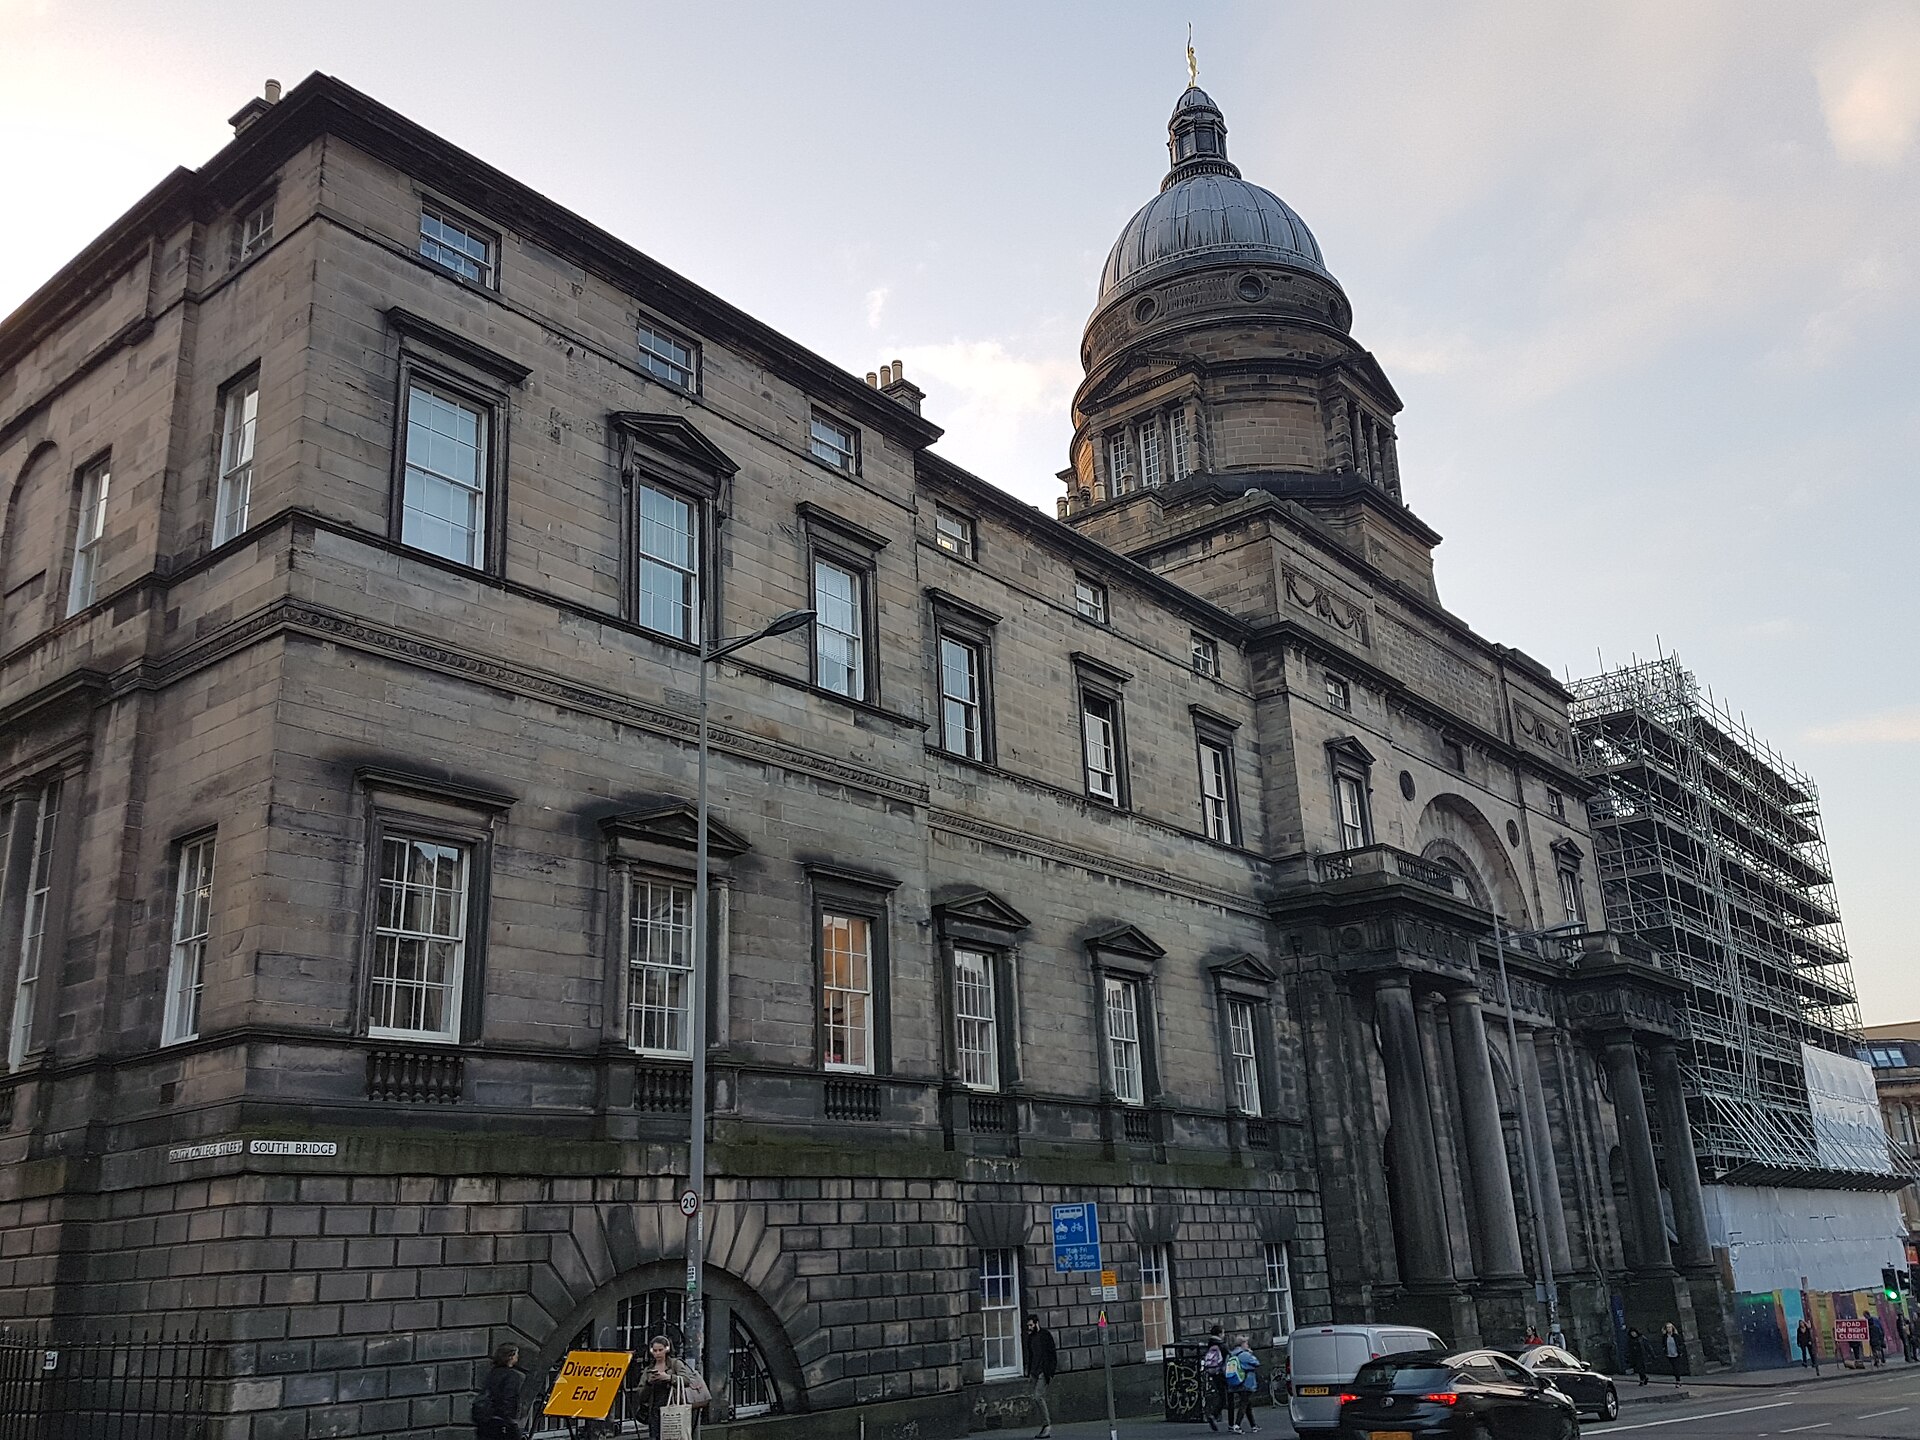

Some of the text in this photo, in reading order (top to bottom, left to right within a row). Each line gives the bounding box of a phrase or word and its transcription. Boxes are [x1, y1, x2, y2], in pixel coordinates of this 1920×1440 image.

[191, 1145, 217, 1158] COLLEGE
[219, 1141, 242, 1155] STREET
[253, 1142, 334, 1155] SOUTH BRIDGE
[683, 1197, 696, 1209] 20
[563, 1361, 622, 1379] Diversion
[571, 1386, 598, 1401] End
